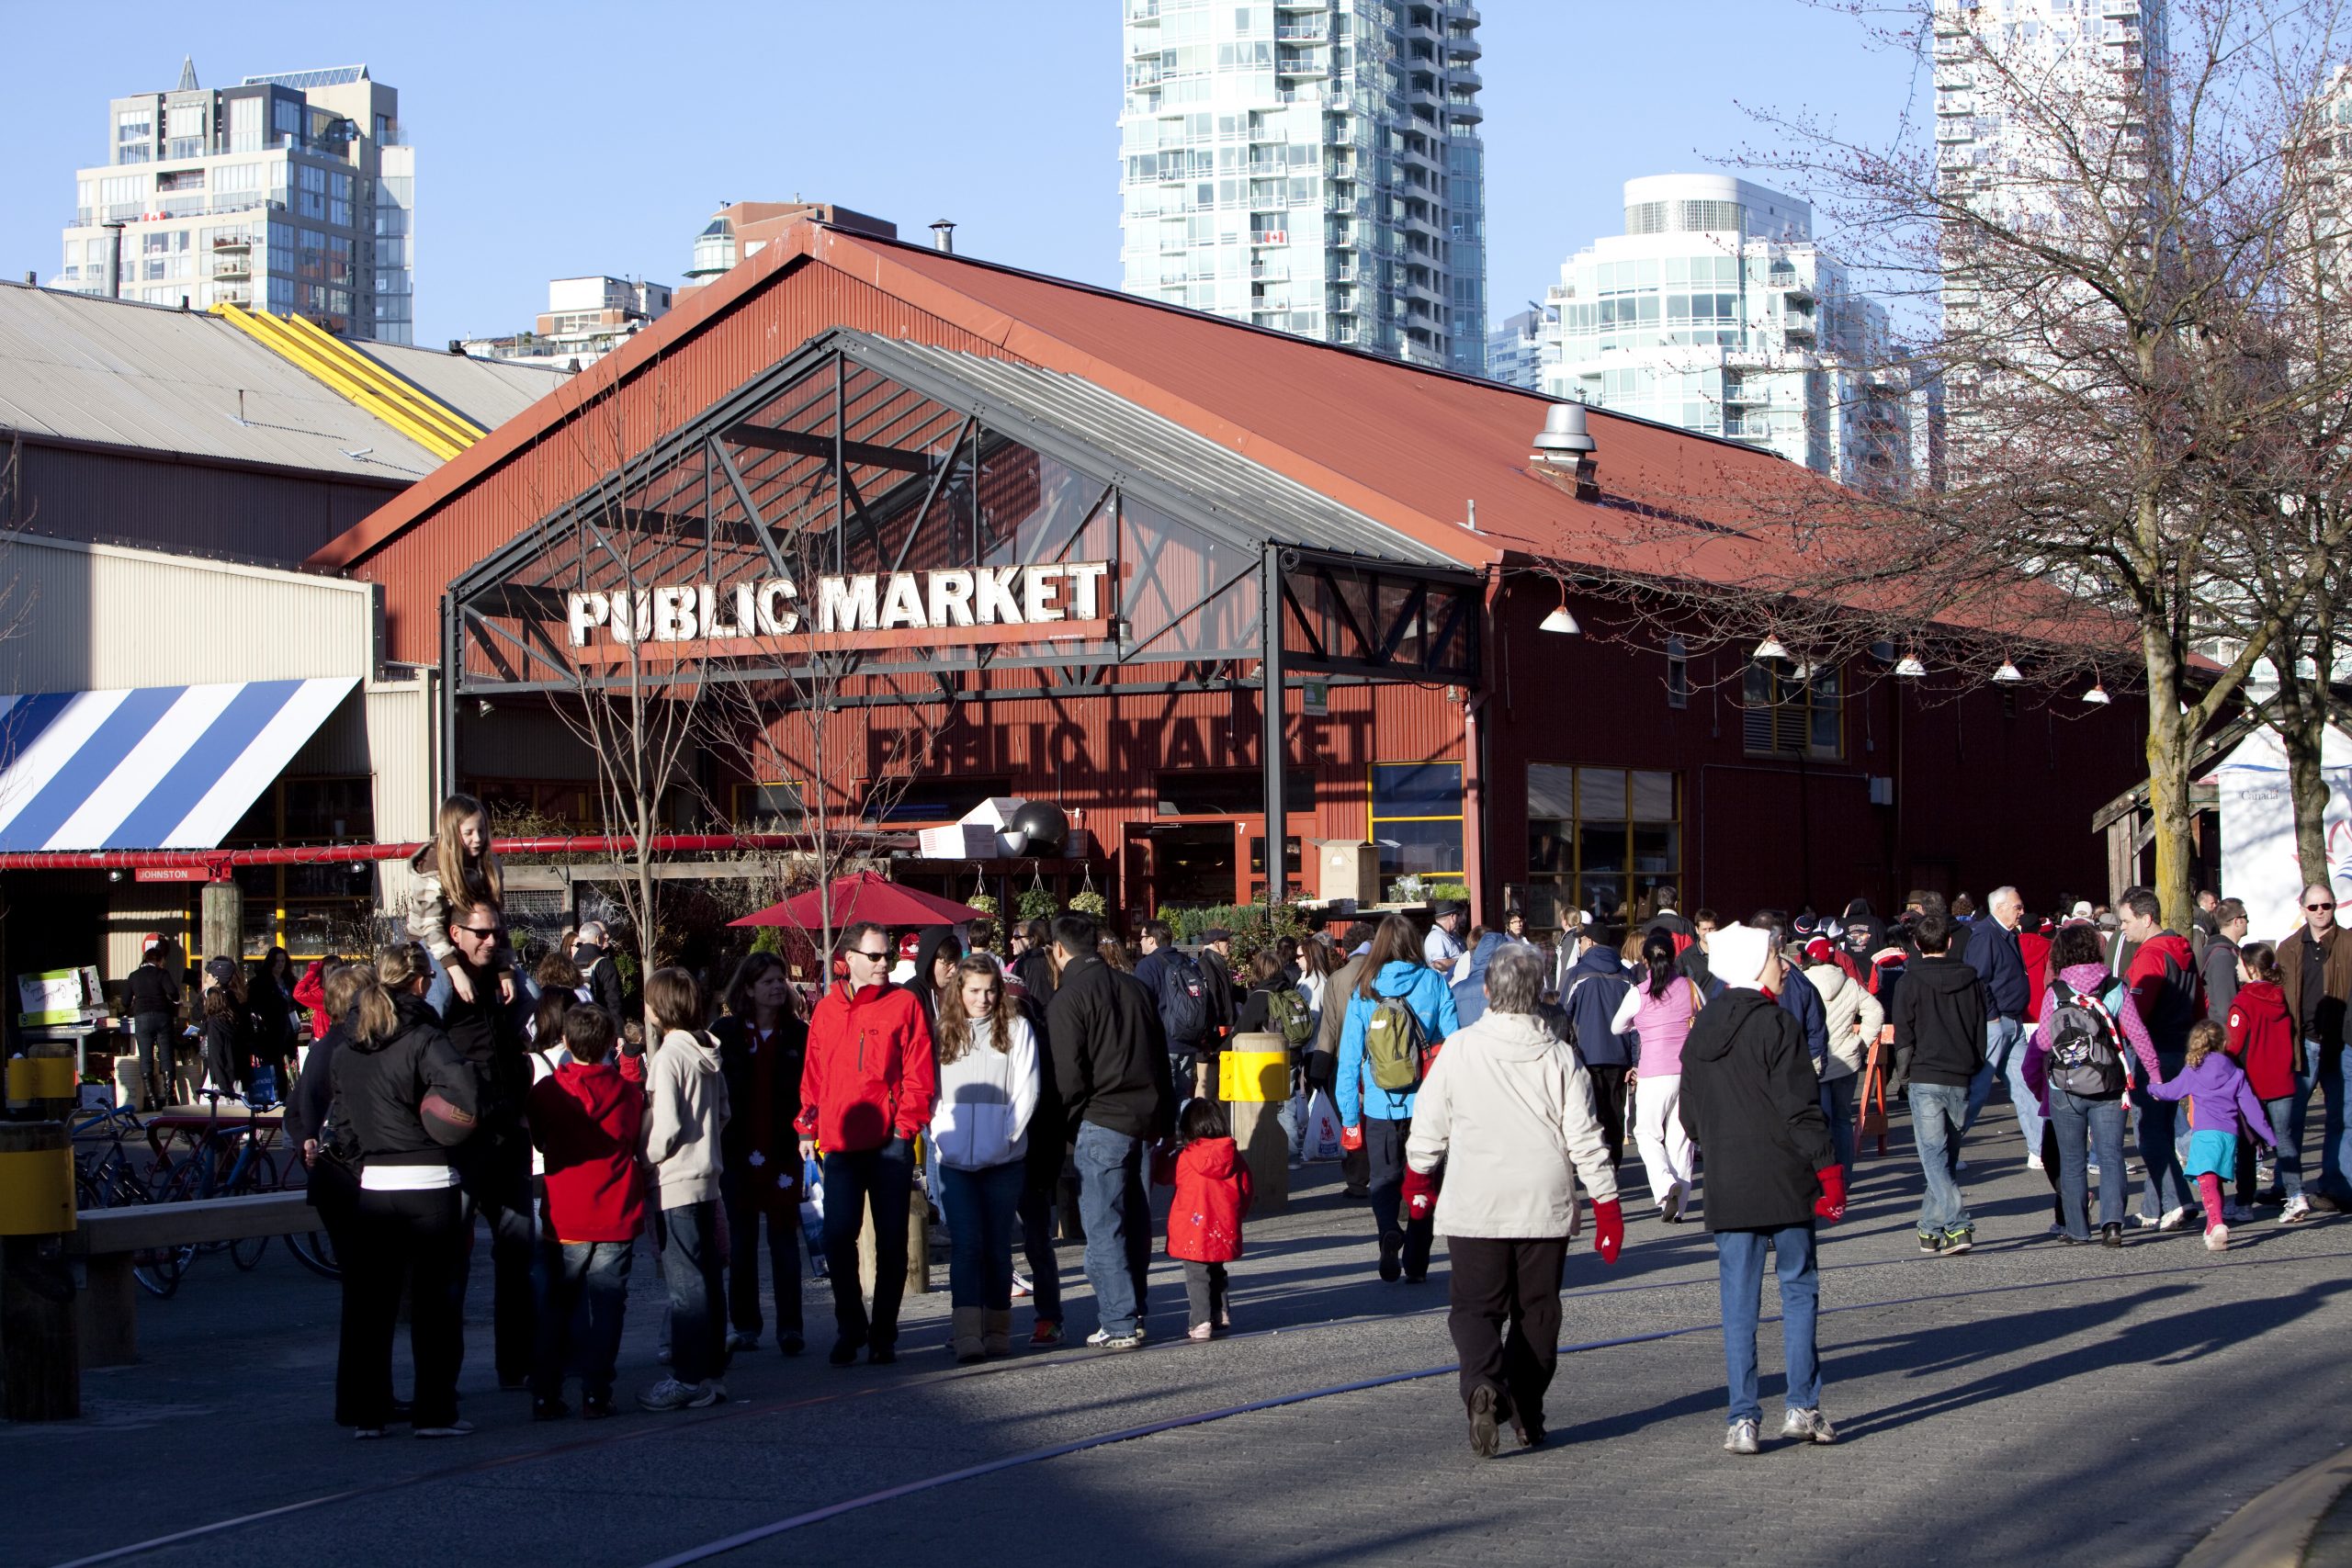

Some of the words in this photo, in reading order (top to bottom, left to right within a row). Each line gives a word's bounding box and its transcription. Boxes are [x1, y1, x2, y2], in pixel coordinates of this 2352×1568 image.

[568, 578, 799, 647] PUBLIC
[818, 559, 1108, 633] MARKET
[2242, 789, 2278, 801] Canada
[1238, 822, 1246, 834] 7
[140, 869, 188, 879] JOHNSTON
